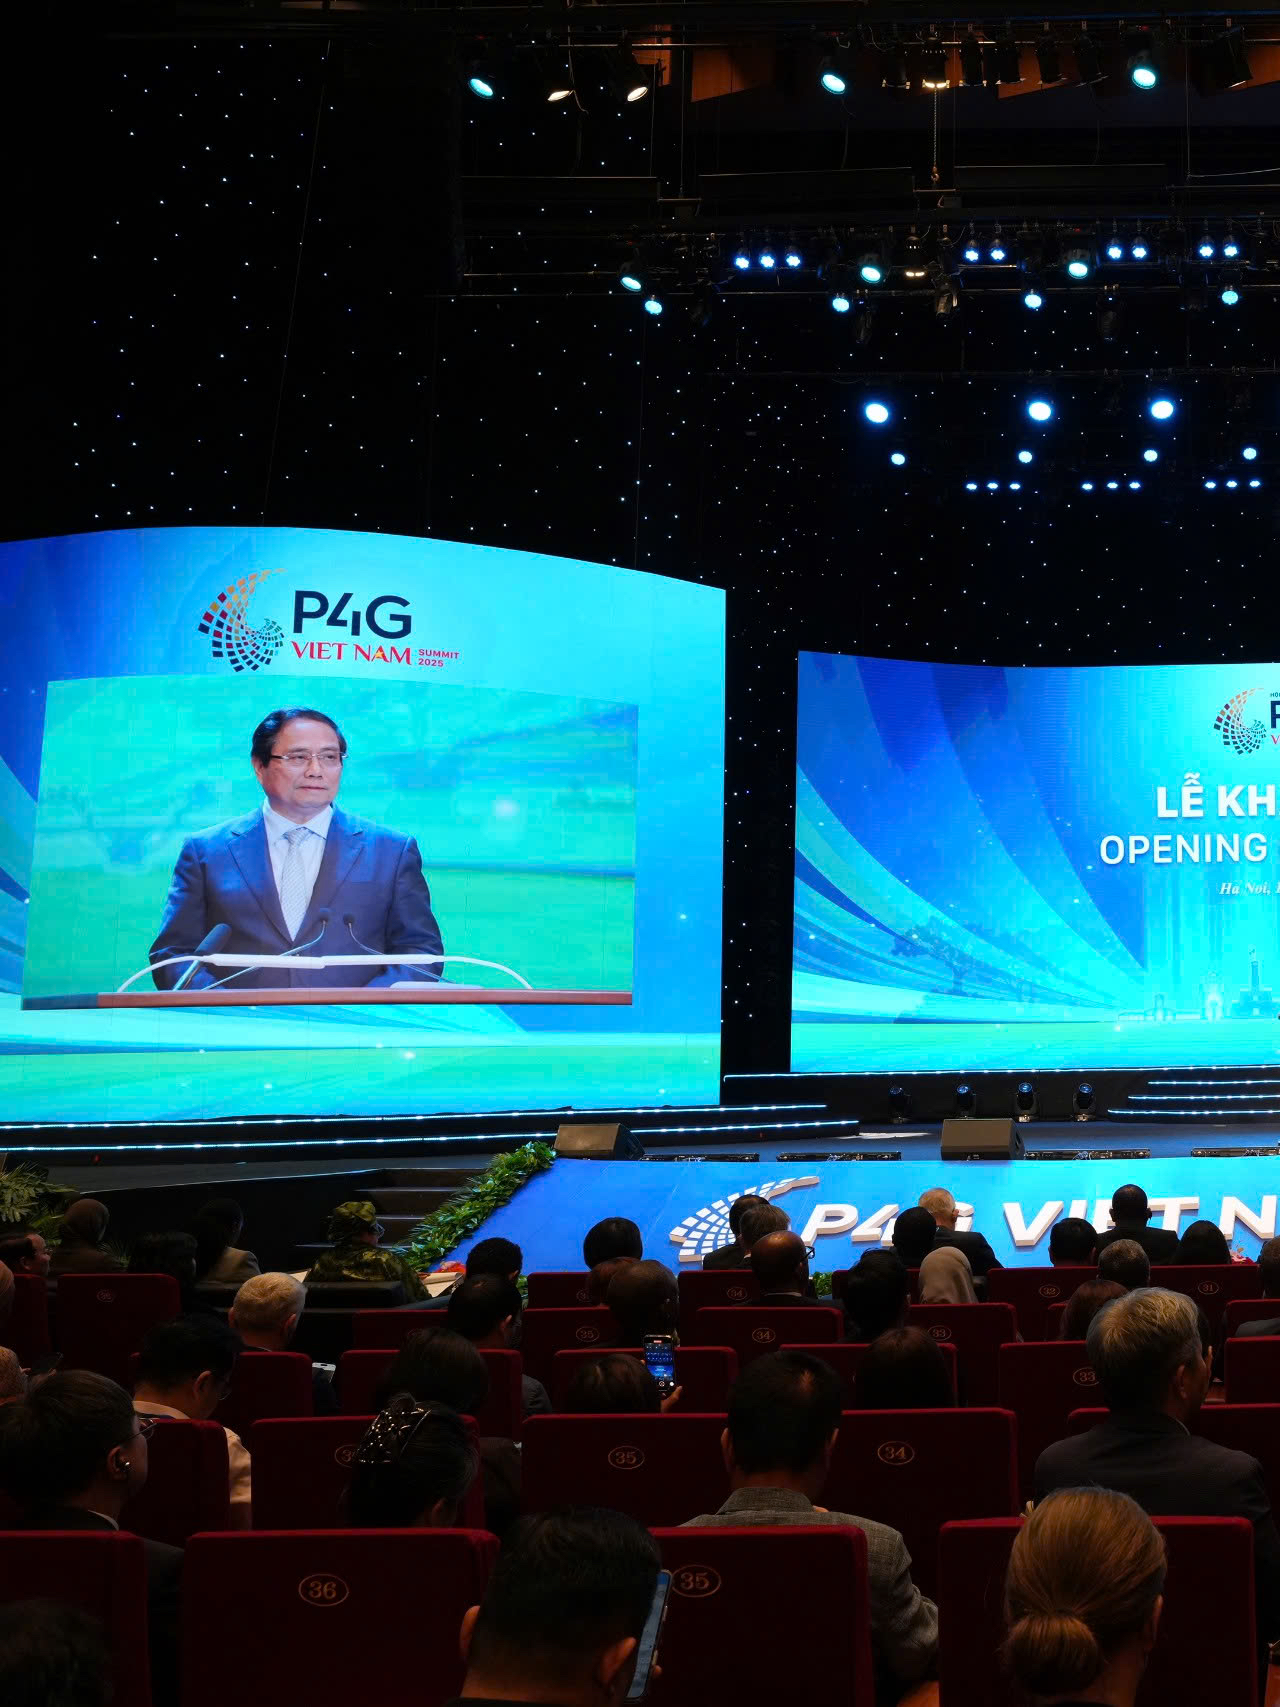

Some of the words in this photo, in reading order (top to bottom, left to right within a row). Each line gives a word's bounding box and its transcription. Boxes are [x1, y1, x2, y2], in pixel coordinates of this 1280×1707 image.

[293, 590, 412, 639] P4G
[291, 641, 348, 660] VIET
[354, 643, 412, 665] NAM
[418, 649, 459, 659] SUMMIT
[418, 658, 444, 667] 2025
[1157, 772, 1204, 818] LỄ
[1100, 832, 1267, 864] OPENING
[1219, 882, 1240, 895] Ha
[1245, 882, 1271, 896] Noi,
[580, 1329, 593, 1338] 35
[756, 1330, 770, 1339] 34
[1080, 1371, 1096, 1382] 33
[616, 1451, 637, 1465] 35
[885, 1447, 905, 1459] 34
[680, 1572, 709, 1590] 35
[309, 1581, 336, 1599] 36
